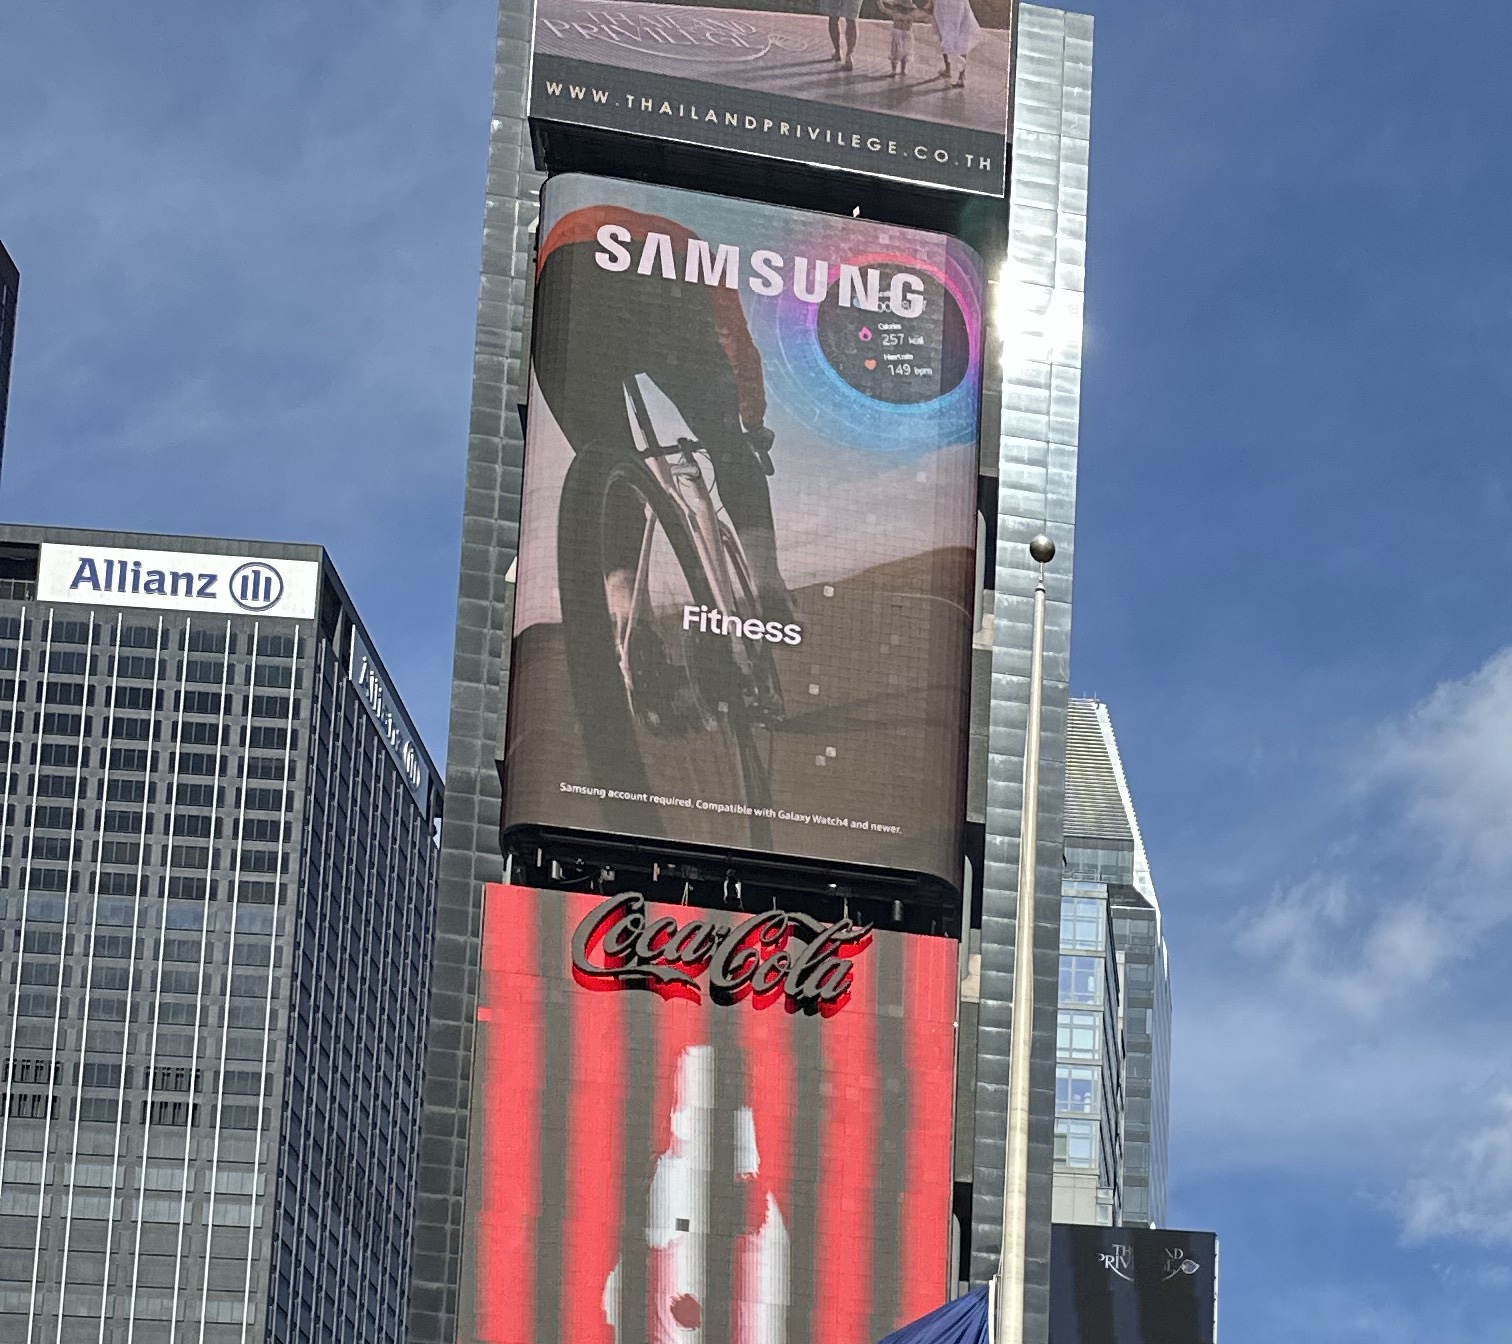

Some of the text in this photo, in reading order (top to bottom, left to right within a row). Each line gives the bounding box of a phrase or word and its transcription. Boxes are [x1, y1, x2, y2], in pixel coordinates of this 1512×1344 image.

[545, 80, 992, 172] WWW.THAILANDPRIVILEGE.CO.TH
[594, 224, 925, 318] SAMSUNG
[882, 334, 905, 346] 257
[887, 364, 911, 376] 149
[69, 557, 218, 599] Allianz
[682, 604, 802, 646] Fitness
[559, 781, 902, 835] Samsung account required. Compatible with Galaxy Watch4 and newer.
